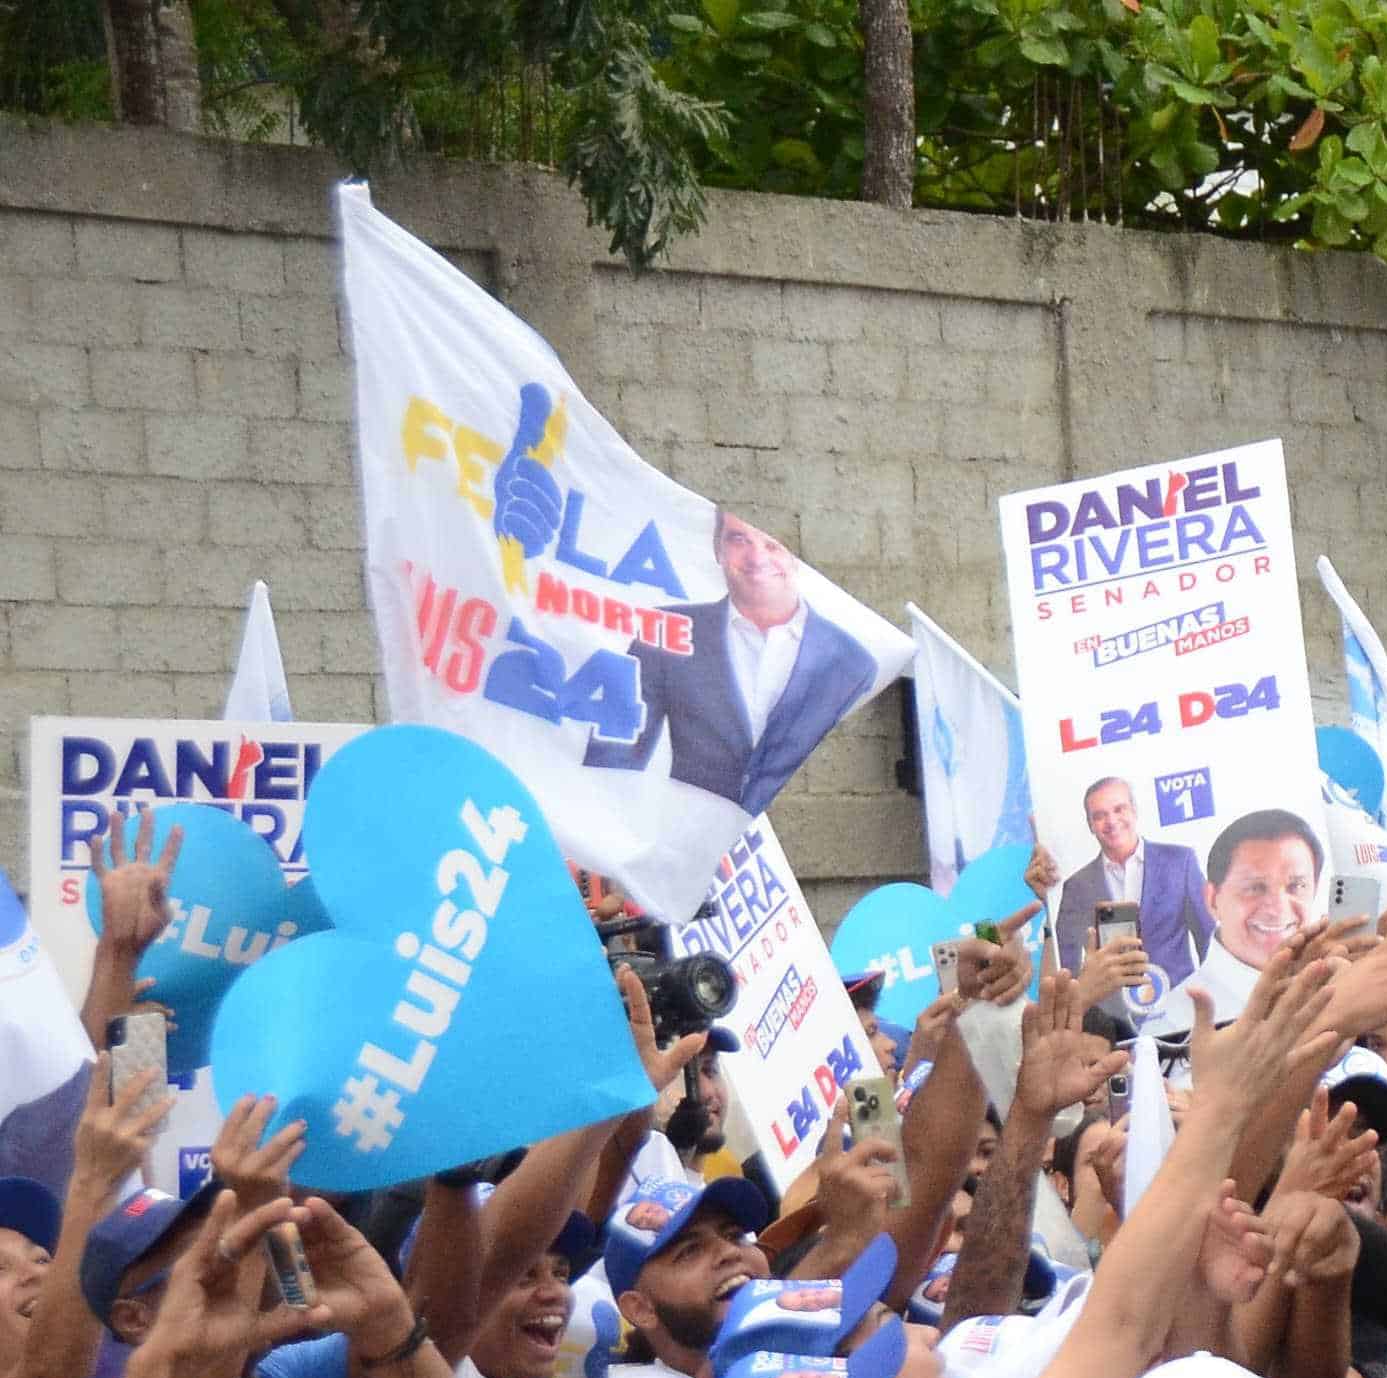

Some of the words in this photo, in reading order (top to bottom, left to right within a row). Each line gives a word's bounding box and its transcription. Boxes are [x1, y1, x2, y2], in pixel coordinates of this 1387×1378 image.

[1026, 461, 1261, 545] DANIEL
[1030, 503, 1267, 592] RIVERA
[536, 570, 694, 657] NORTE
[1037, 554, 1273, 621] SENADOR
[1098, 606, 1222, 663] BUENAS
[1178, 619, 1248, 652] MANOS
[483, 615, 648, 742] 24
[1059, 701, 1163, 753] L24
[1178, 674, 1280, 728] D24
[1159, 773, 1207, 794] VOTA
[1174, 789, 1195, 820] 1
[332, 796, 530, 1154] #Luis24
